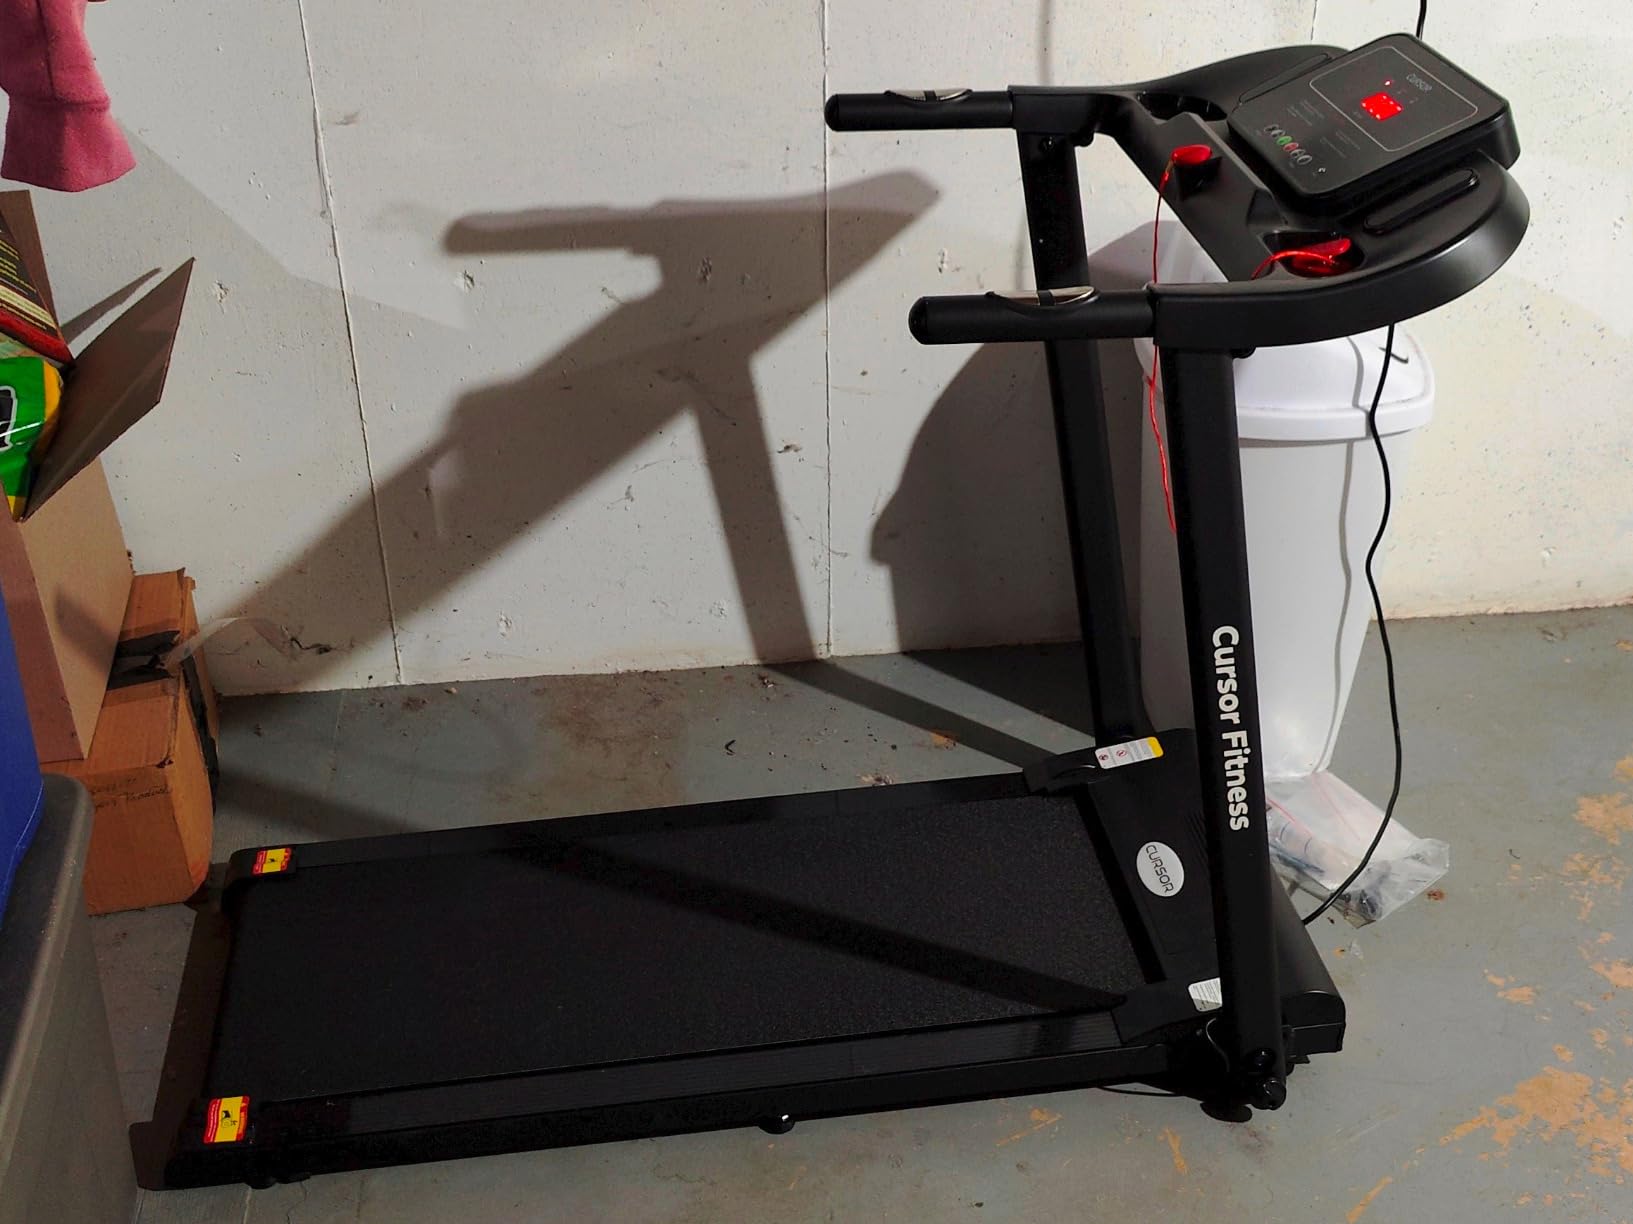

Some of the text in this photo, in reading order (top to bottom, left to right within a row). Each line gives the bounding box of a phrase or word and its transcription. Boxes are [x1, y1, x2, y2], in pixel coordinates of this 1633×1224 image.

[1212, 625, 1251, 831] Cursor Fitness
[1145, 844, 1174, 893] CURSOR
